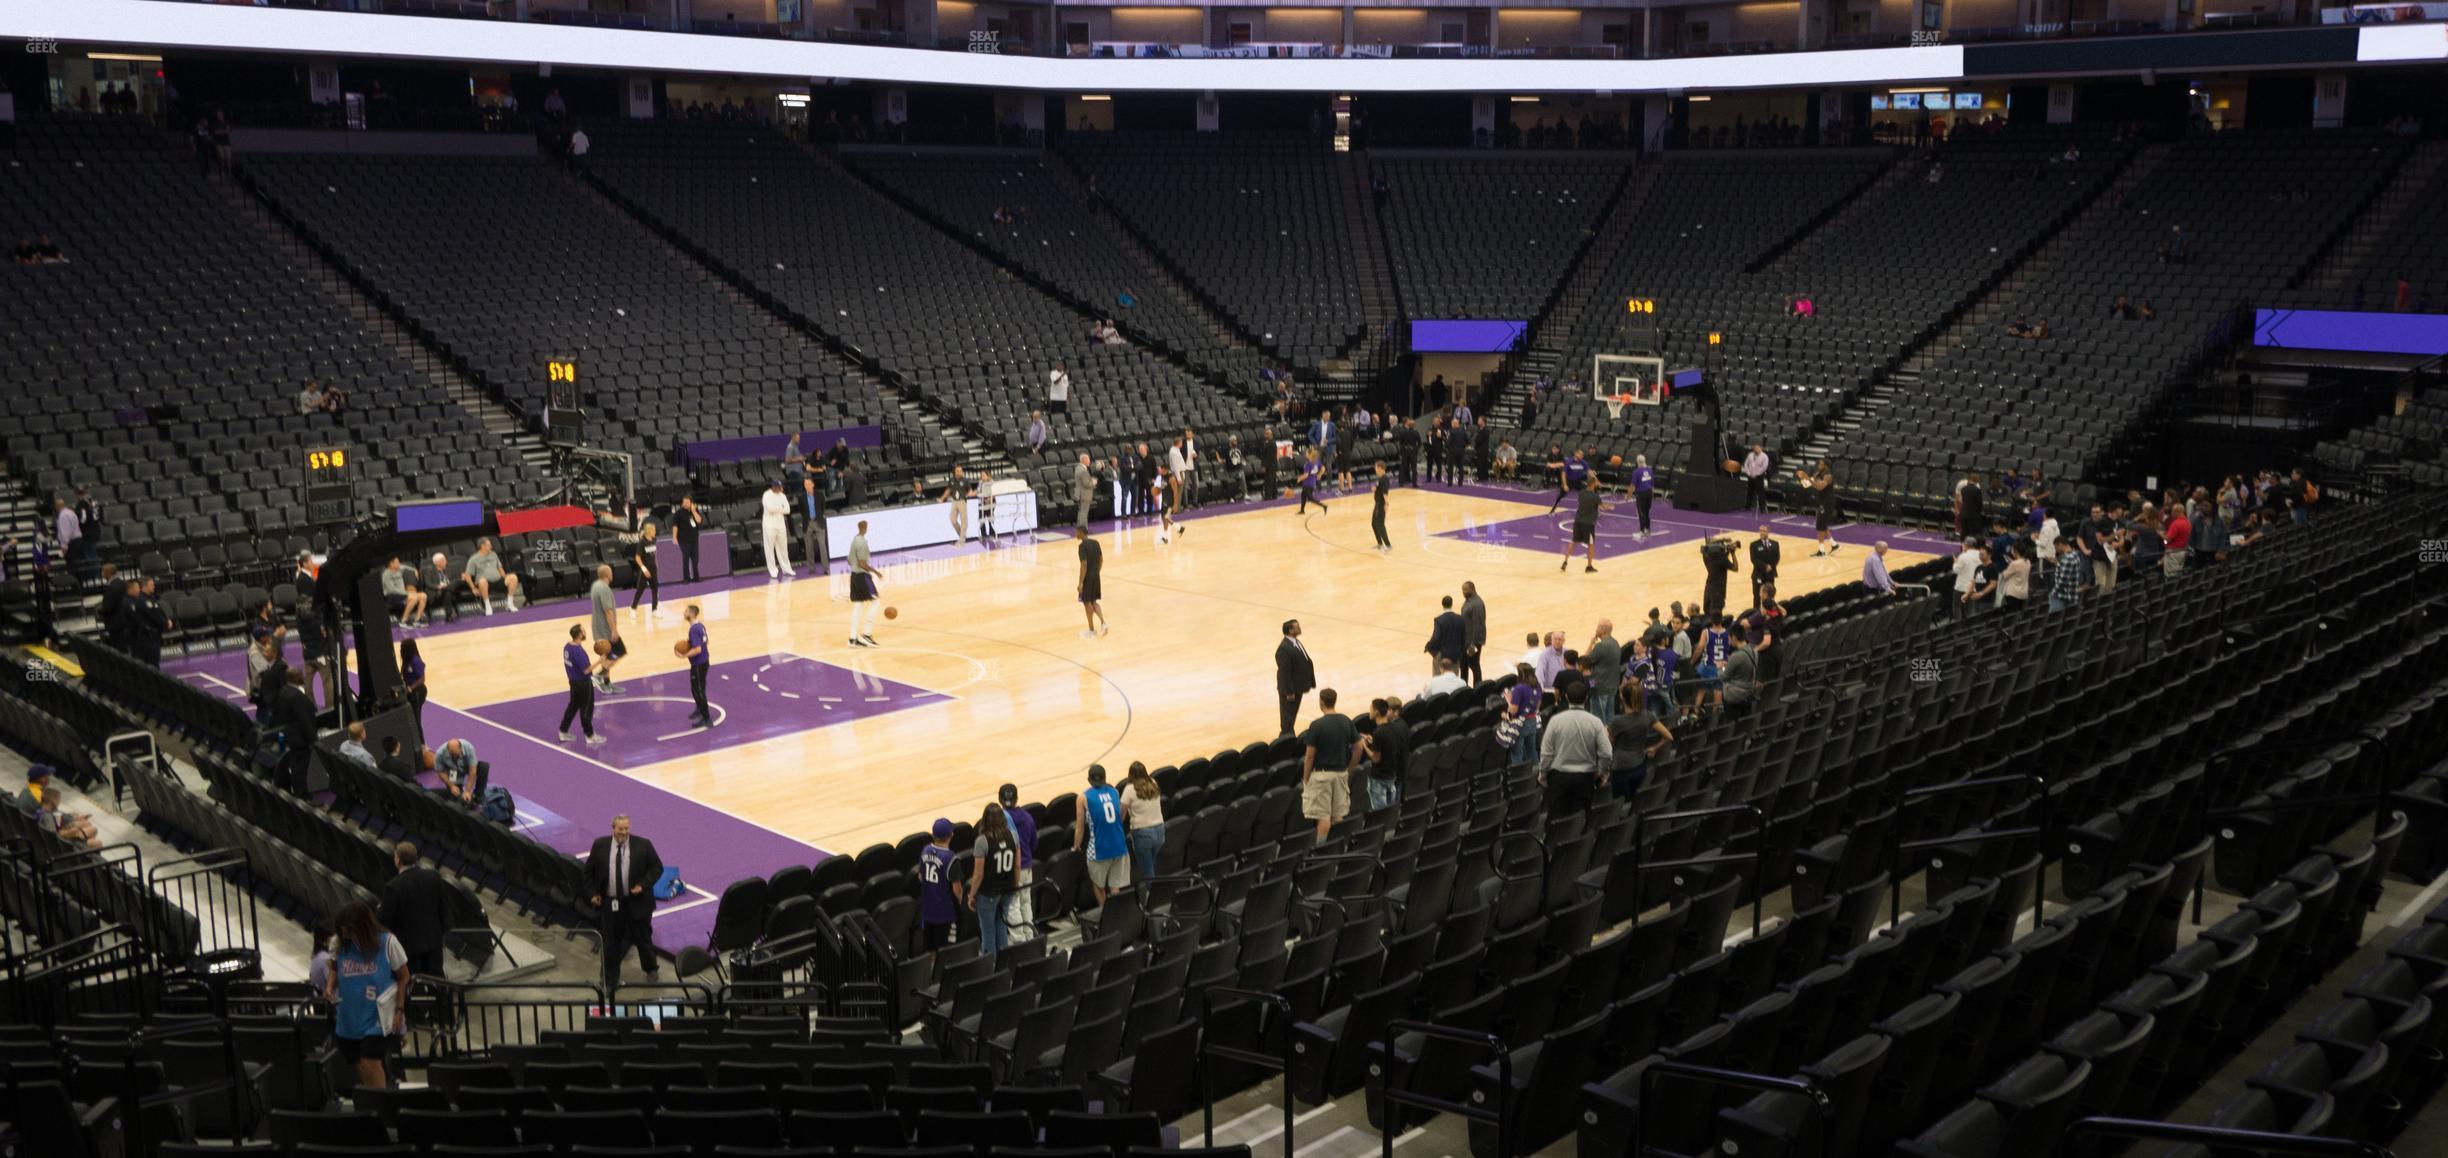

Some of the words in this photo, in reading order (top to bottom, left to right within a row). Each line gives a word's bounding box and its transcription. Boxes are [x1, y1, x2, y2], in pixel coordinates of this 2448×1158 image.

[316, 71, 332, 89] 107
[1628, 299, 1654, 314] 57:18
[549, 362, 575, 383] 57:18
[309, 450, 345, 470] 57:18
[1713, 645, 1724, 660] 5
[1103, 801, 1116, 824] 0
[993, 849, 1014, 874] 10
[925, 862, 939, 884] 16
[365, 986, 377, 1001] 5
